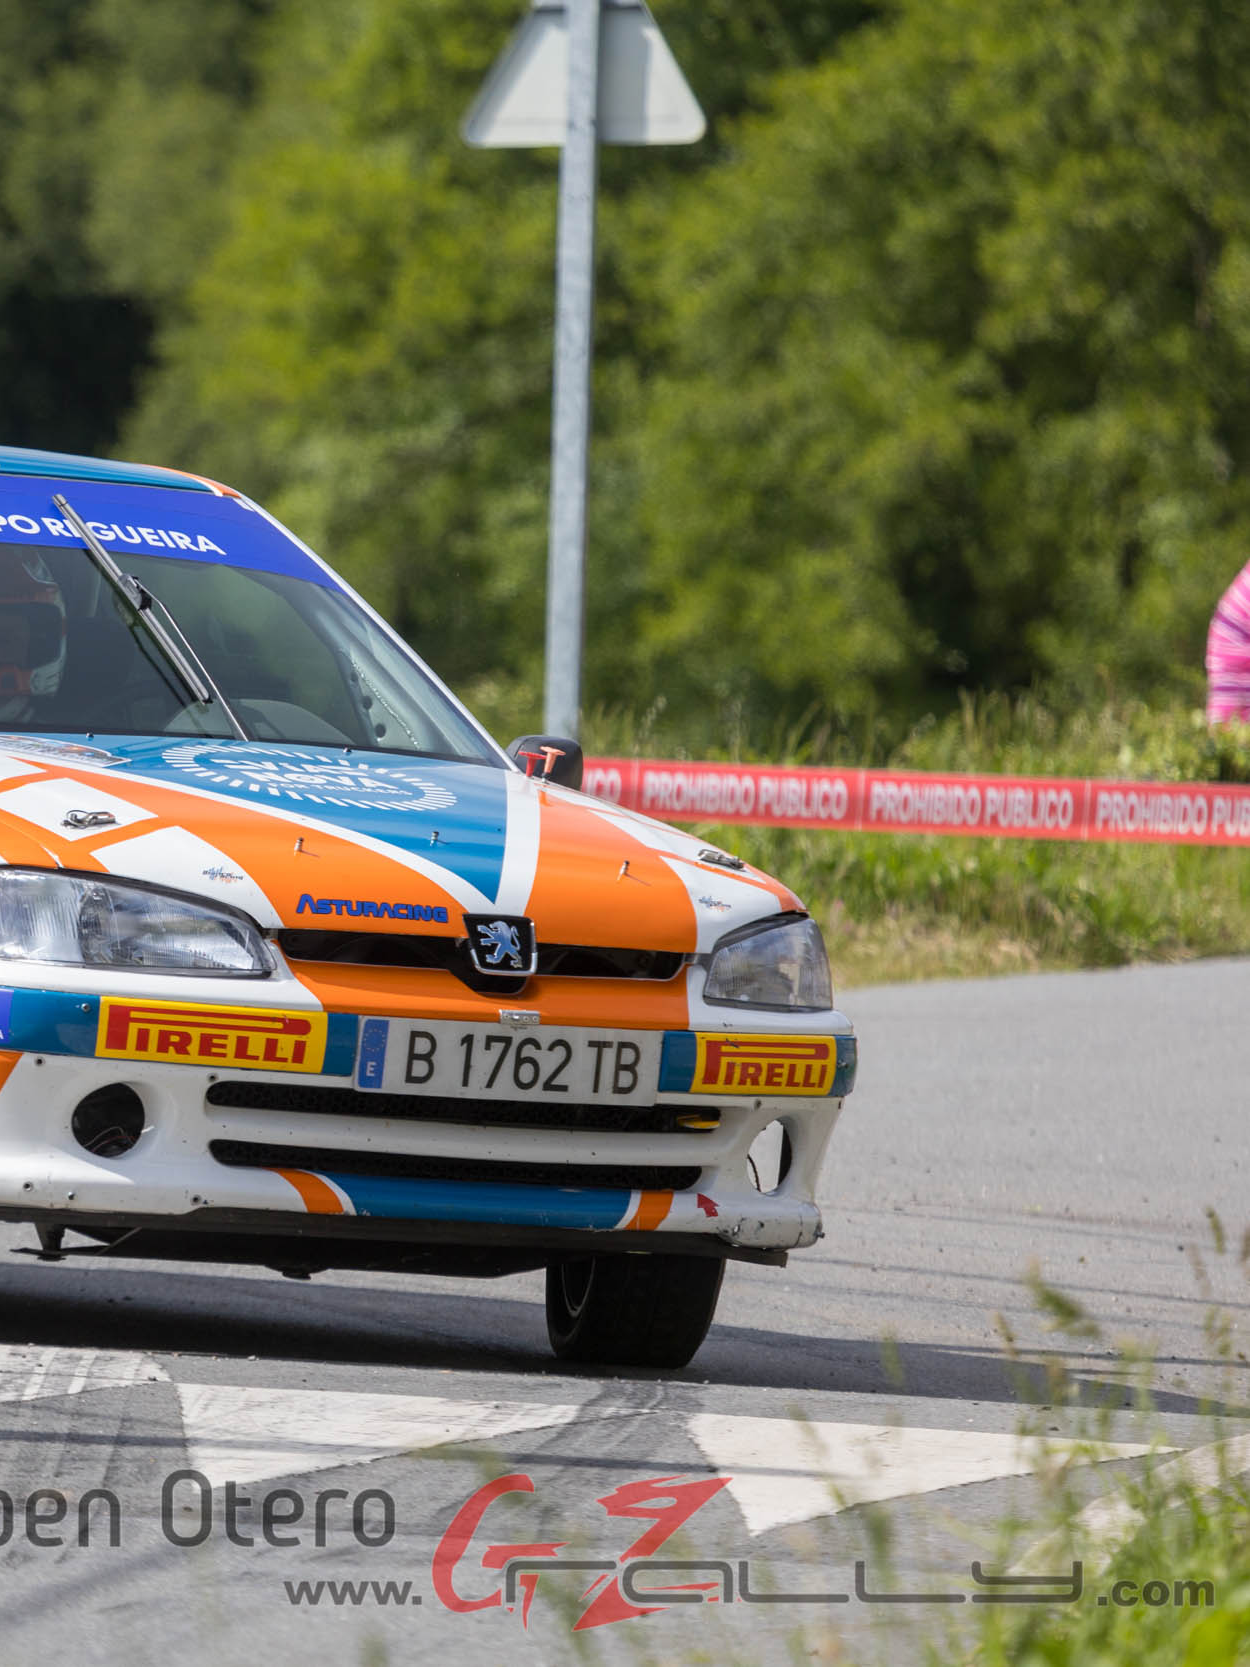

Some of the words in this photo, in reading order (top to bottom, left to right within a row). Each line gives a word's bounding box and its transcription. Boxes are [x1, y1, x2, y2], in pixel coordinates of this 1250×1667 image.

[240, 770, 400, 790] NOVA
[643, 771, 756, 815] PROHIBIDO
[758, 775, 849, 821] PUBLICO
[869, 780, 981, 825] PROHIBIDO
[983, 786, 1073, 830] PUBLICO
[1096, 790, 1208, 836] PROHIBIDO
[296, 893, 449, 923] ASTURACING
[105, 1004, 312, 1064] PIRELLI
[365, 1061, 376, 1077] E
[405, 1030, 438, 1084] B
[460, 1033, 573, 1093] 1762
[588, 1040, 641, 1095] TB
[702, 1040, 830, 1089] PIRELLI
